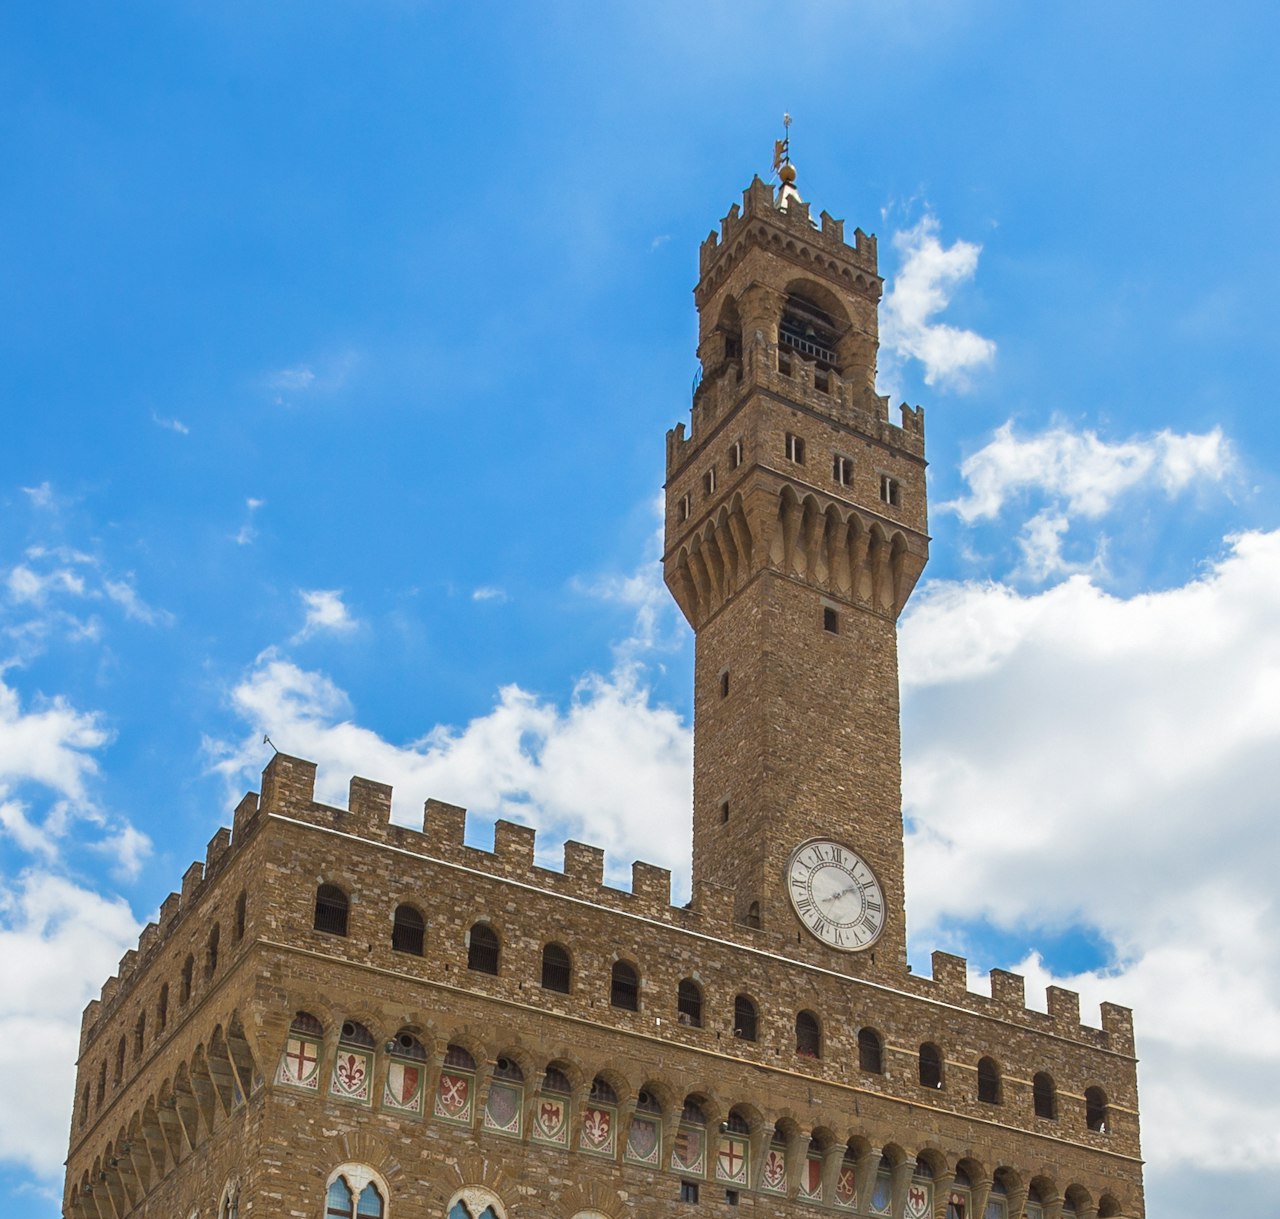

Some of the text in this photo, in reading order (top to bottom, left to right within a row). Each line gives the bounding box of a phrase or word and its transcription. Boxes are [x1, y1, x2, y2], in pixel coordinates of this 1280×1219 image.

[811, 845, 824, 862] XI
[830, 846, 842, 862] XII
[797, 856, 812, 873] X
[851, 860, 859, 871] I
[792, 876, 807, 890] IX
[862, 880, 875, 890] II
[796, 898, 811, 916] VIII
[867, 901, 881, 913] III
[812, 917, 825, 936] VII
[834, 928, 844, 945] VI
[853, 931, 863, 945] V
